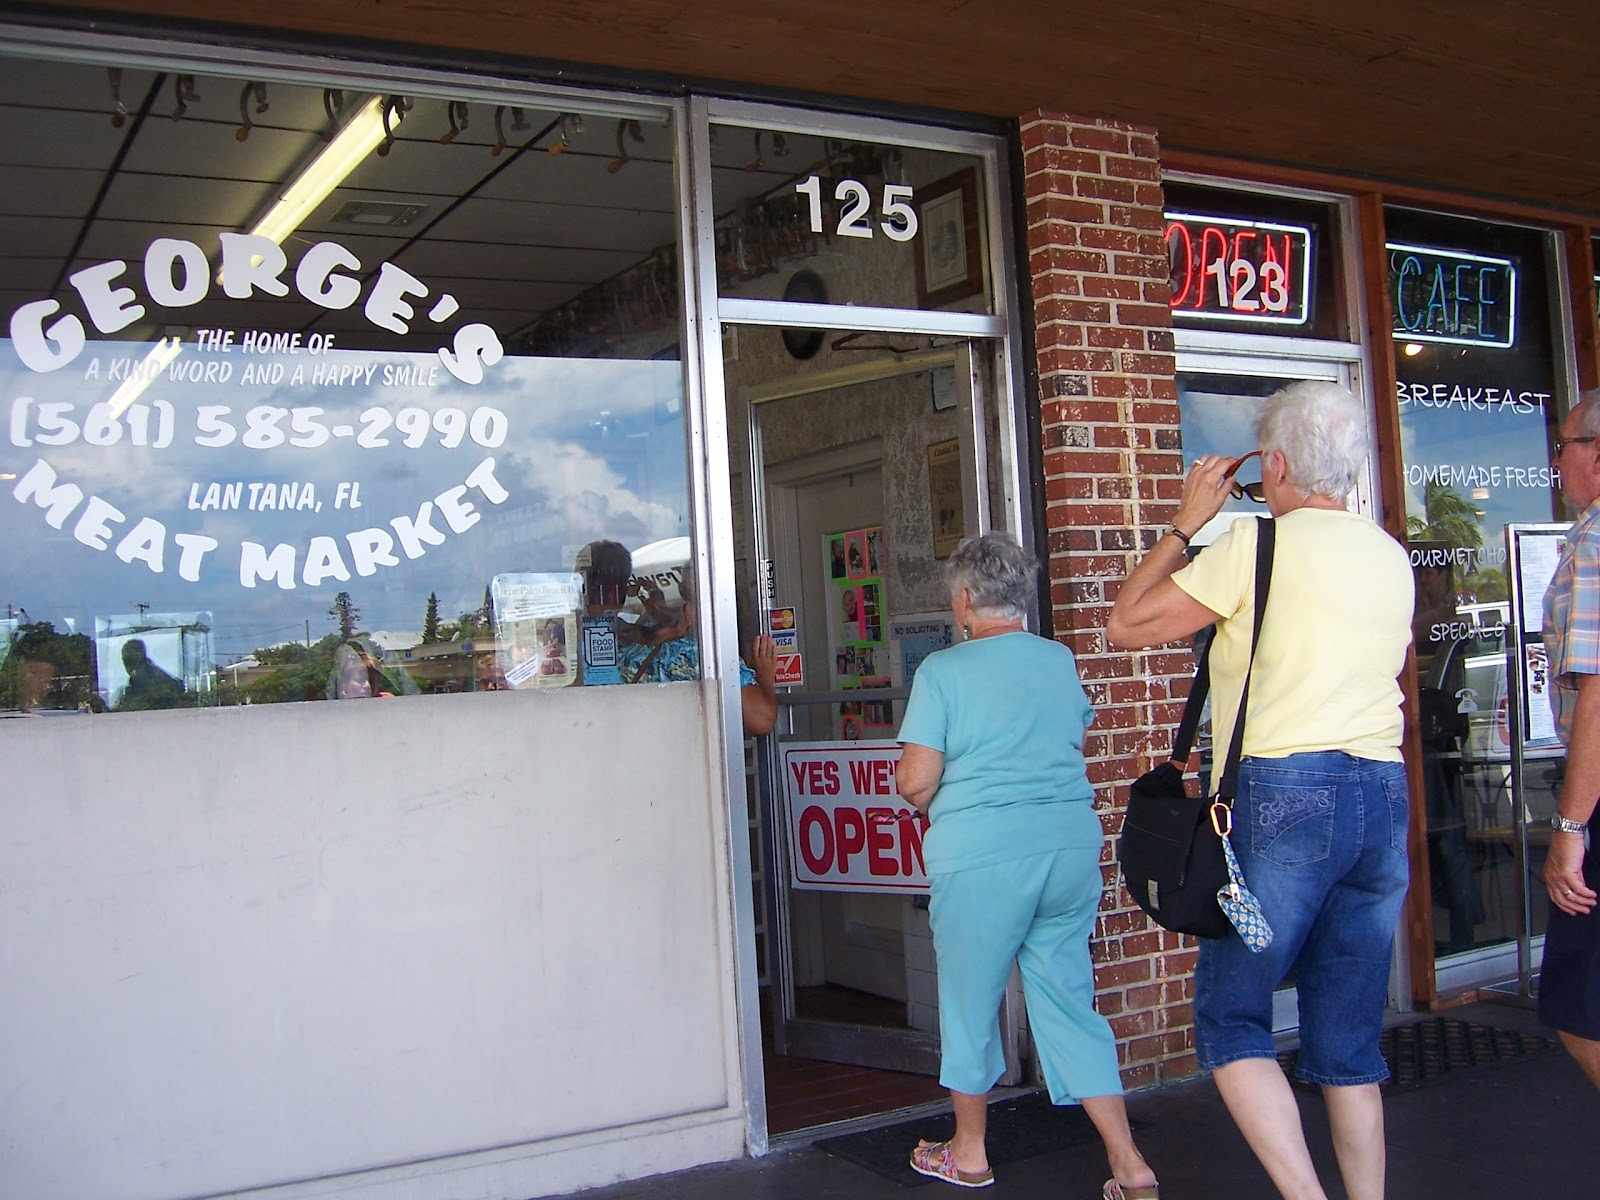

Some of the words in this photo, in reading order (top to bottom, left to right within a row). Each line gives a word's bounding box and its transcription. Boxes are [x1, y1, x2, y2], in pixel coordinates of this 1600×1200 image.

[796, 175, 918, 241] 125
[1164, 222, 1290, 313] OPEN
[1207, 257, 1288, 311] 123
[10, 232, 503, 384] GEORGE'S
[1398, 256, 1497, 338] CAFE
[197, 328, 234, 352] THE
[242, 330, 302, 355] HOME
[308, 333, 335, 355] OF
[84, 357, 100, 381] A
[108, 358, 161, 381] KIND
[169, 360, 233, 383] WORD
[240, 362, 284, 386] AND
[290, 364, 304, 386] A
[311, 362, 377, 387] HAPPY
[382, 365, 439, 387] SMILE
[1396, 381, 1550, 416] BREAKFAST
[9, 397, 175, 449] (561)
[194, 404, 509, 449] 585-2990
[1504, 465, 1562, 489] FRESH
[334, 481, 362, 509] FL
[13, 458, 218, 582] MEAT
[239, 456, 510, 590] MARKET
[1410, 547, 1475, 567] OURMET
[1477, 546, 1506, 565] CHO
[766, 562, 775, 597] PUSH
[592, 638, 614, 646] FOOD
[775, 637, 793, 647] VISA
[894, 627, 904, 635] NO
[791, 761, 841, 795] YES
[799, 805, 931, 877] OPEN
